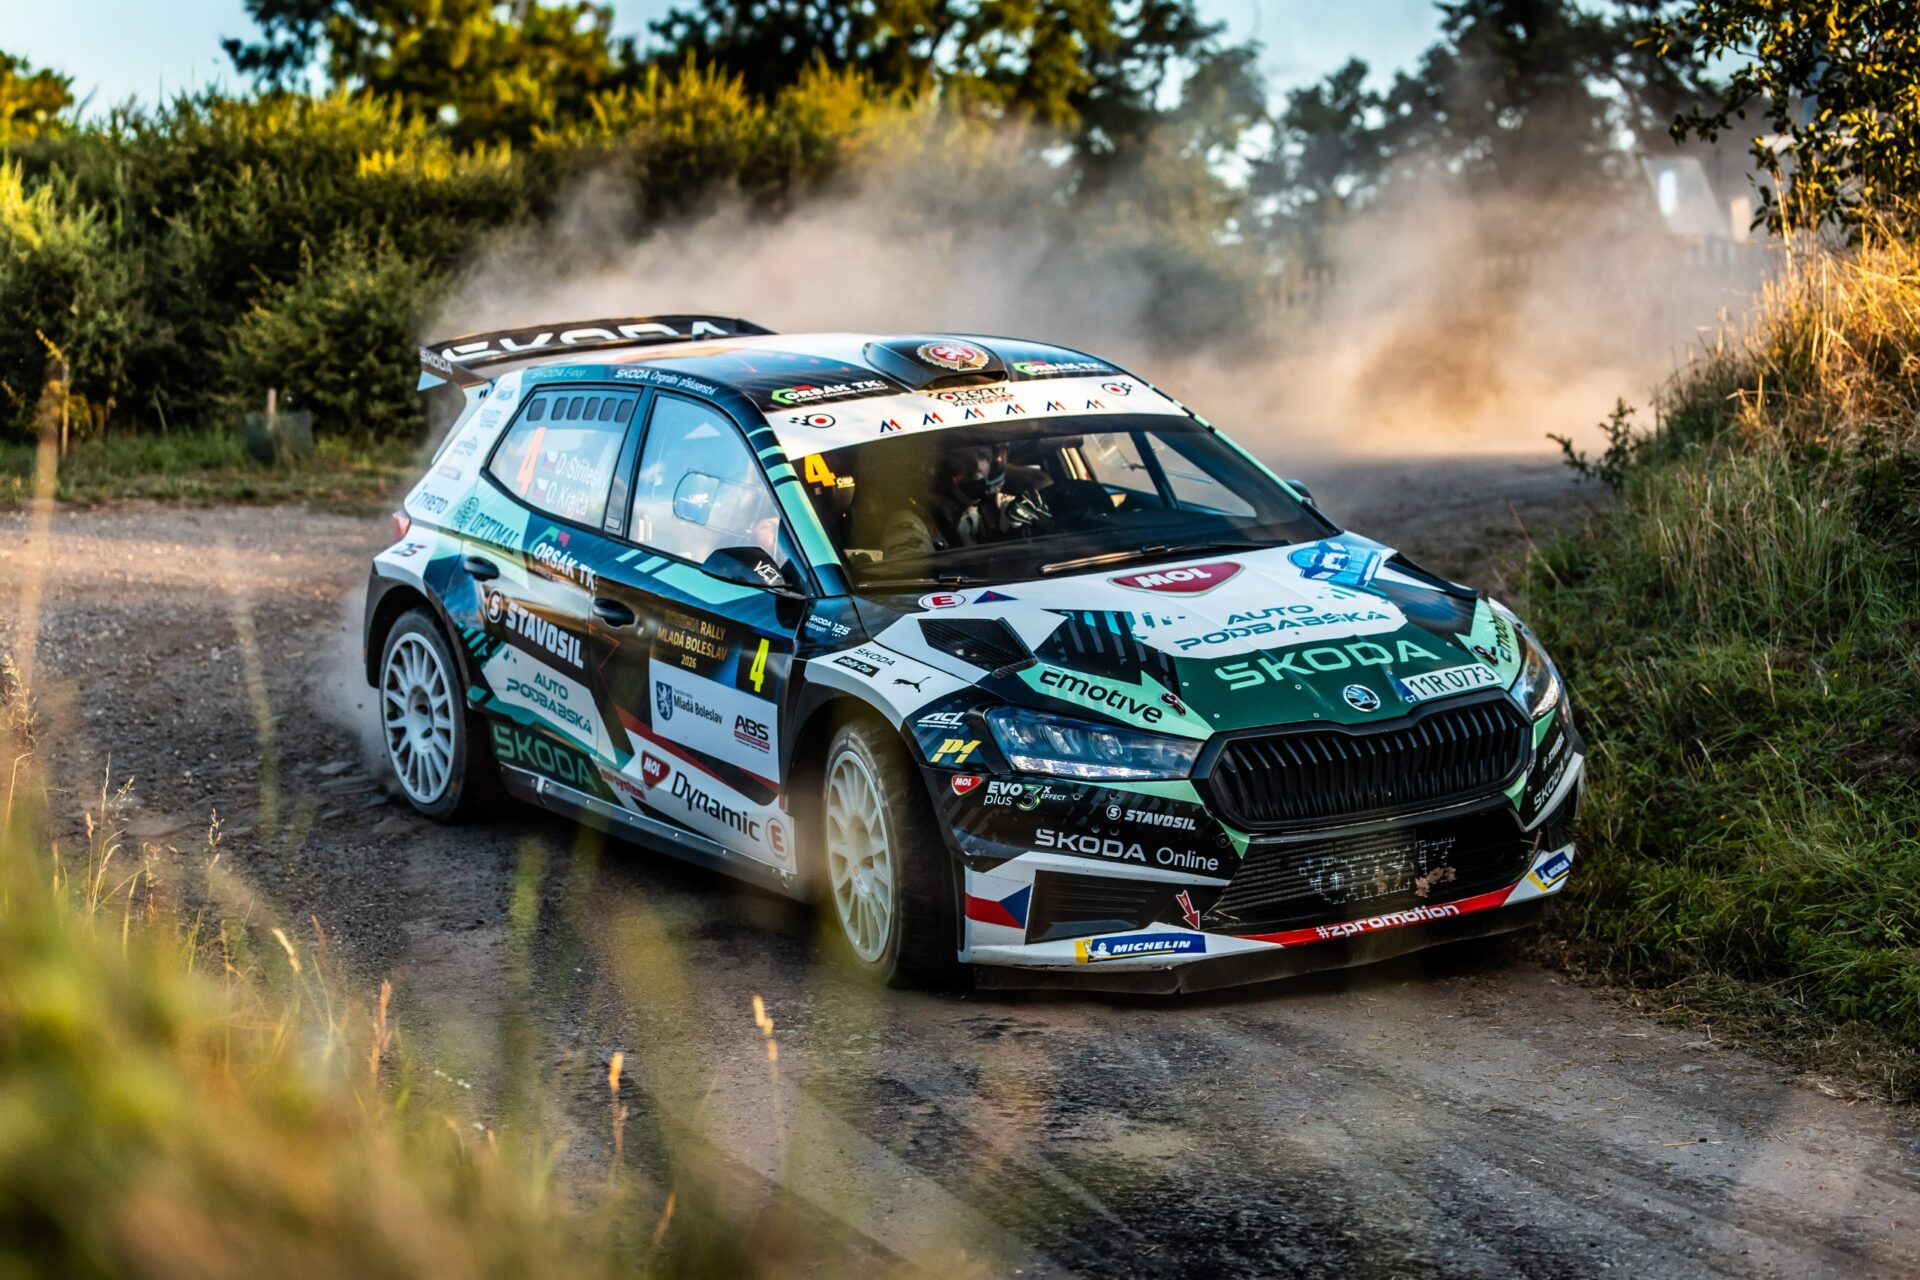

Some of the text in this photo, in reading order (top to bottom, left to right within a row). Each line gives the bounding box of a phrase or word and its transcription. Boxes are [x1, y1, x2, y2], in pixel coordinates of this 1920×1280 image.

[614, 368, 650, 381] SKODA
[516, 426, 547, 495] 4
[555, 453, 567, 476] D.
[804, 453, 836, 487] 4
[533, 542, 578, 579] ORSÁK
[1133, 567, 1213, 588] MOL
[809, 614, 851, 636] SKODA 125
[1227, 605, 1314, 625] AUTO
[505, 601, 584, 669] STAVOSIL
[700, 621, 727, 641] RALLY
[657, 626, 728, 661] MLADÁ BOLESLAV
[749, 638, 770, 693] 4
[854, 647, 896, 666] SKODA
[1214, 640, 1441, 690] SKODA
[533, 672, 569, 700] AUTO
[1444, 666, 1496, 688] 0773
[673, 694, 722, 724] Mladá Boleslav
[734, 714, 769, 741] ABS
[494, 724, 600, 793] SKODA
[644, 756, 661, 777] MOL
[954, 777, 972, 787] MOL
[986, 780, 1023, 797] EVO
[671, 770, 760, 842] Dynamic
[983, 793, 1013, 806] plus
[1040, 793, 1067, 801] EFFECT
[1124, 809, 1196, 831] STAVOSIL
[1034, 828, 1219, 871] SKODA Online
[1315, 904, 1461, 939] #zpromotion
[1112, 940, 1191, 954] MICHELIN
